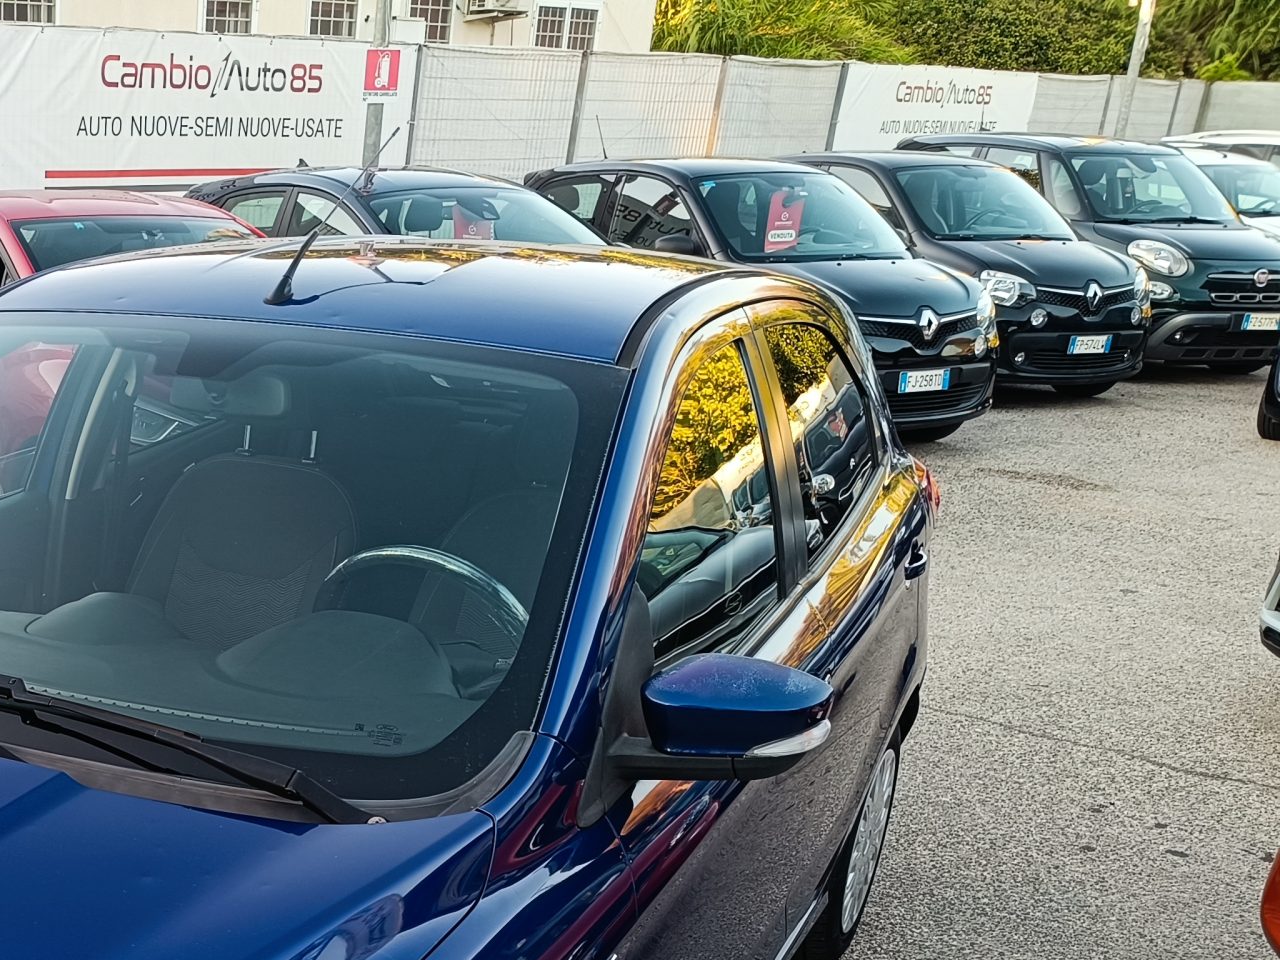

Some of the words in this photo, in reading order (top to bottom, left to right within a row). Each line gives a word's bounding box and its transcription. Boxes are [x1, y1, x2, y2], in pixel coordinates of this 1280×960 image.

[101, 53, 212, 90] Cambio
[290, 63, 323, 93] 85
[896, 80, 944, 103] Cambio
[976, 86, 993, 105] 85
[77, 116, 122, 136] AUTO
[131, 116, 234, 137] NUOVE-SEMI
[238, 117, 344, 138] NUOVE-USATE
[880, 121, 901, 133] AUTO
[950, 120, 997, 132] NUOVE-UATE
